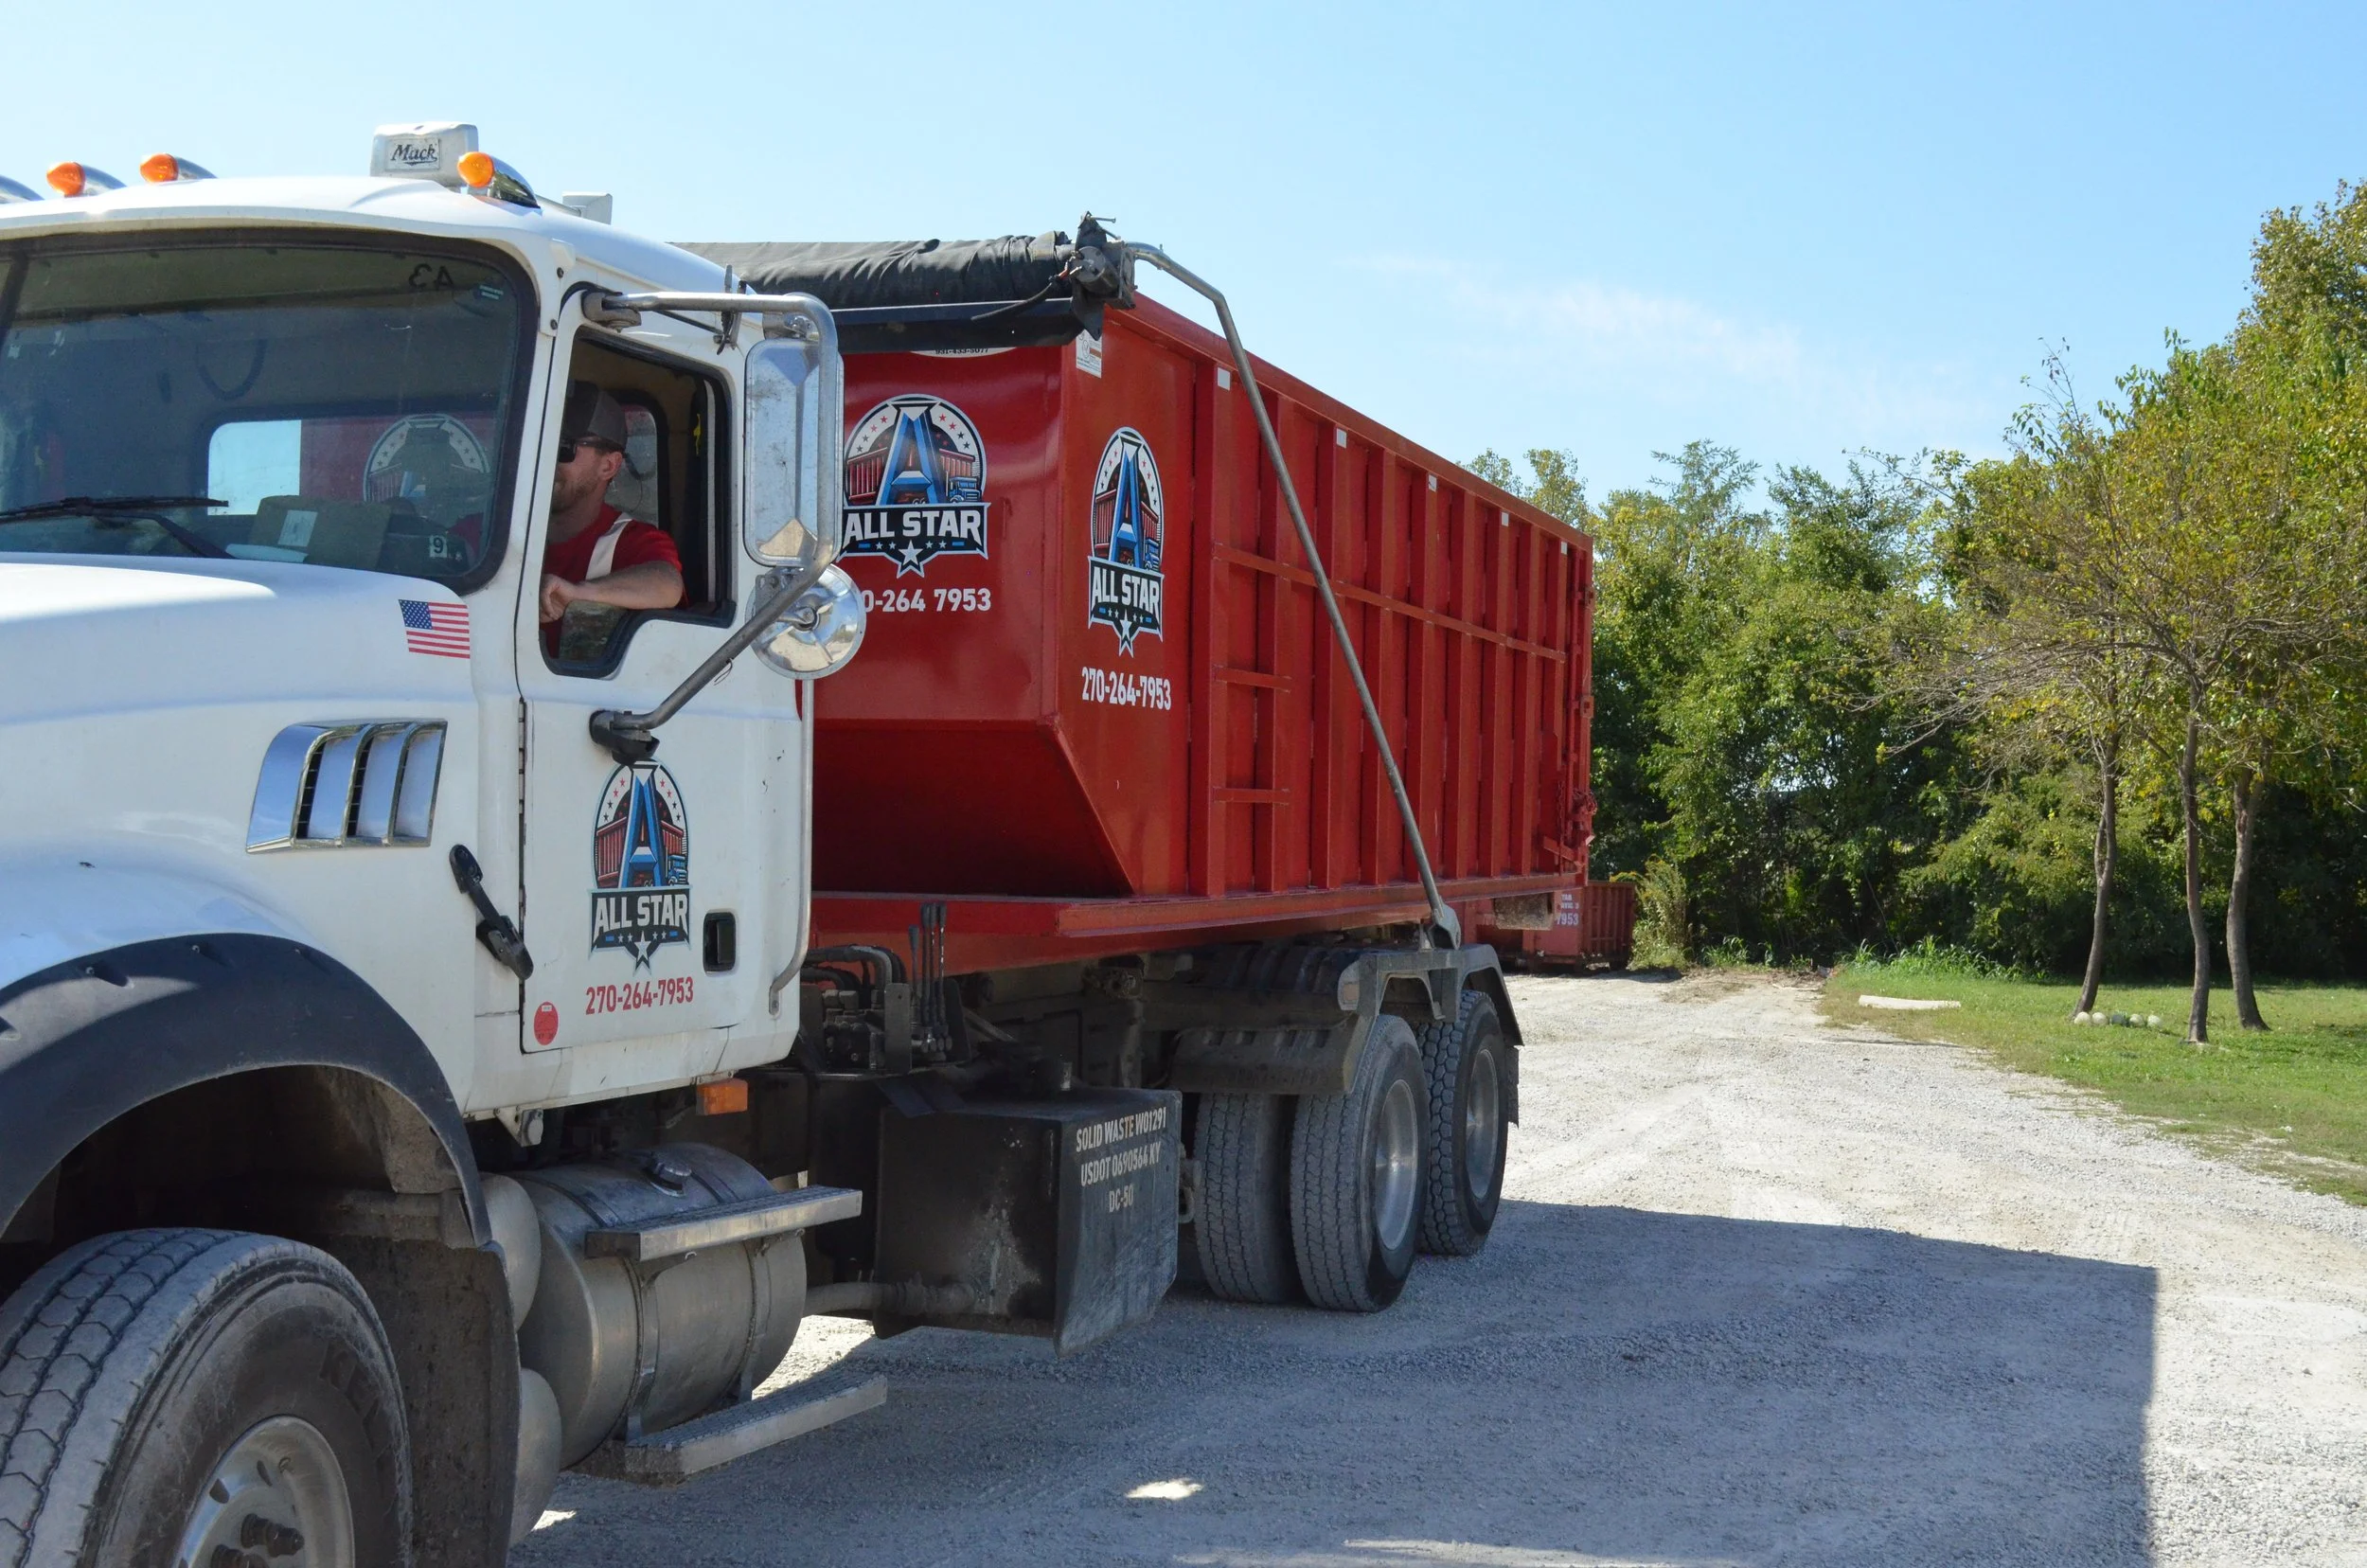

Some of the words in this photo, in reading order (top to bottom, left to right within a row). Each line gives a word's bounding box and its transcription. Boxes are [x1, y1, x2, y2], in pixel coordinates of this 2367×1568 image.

[390, 143, 438, 165] Mack
[432, 536, 444, 554] 9
[843, 511, 896, 549] ALL
[902, 509, 982, 546] STAR
[934, 587, 991, 612] 7953
[1091, 566, 1118, 612] ALL
[1121, 573, 1161, 627] STAR
[1081, 667, 1172, 710] 270-264-7953
[593, 897, 632, 943] ALL
[636, 893, 689, 939] STAR
[585, 976, 694, 1015] 270-264-7953
[1076, 1124, 1103, 1152] SOLID
[1104, 1114, 1134, 1144] WASTE
[1080, 1156, 1111, 1187] USDOT
[1148, 1141, 1162, 1166] KY
[1109, 1184, 1134, 1213] DC-50
